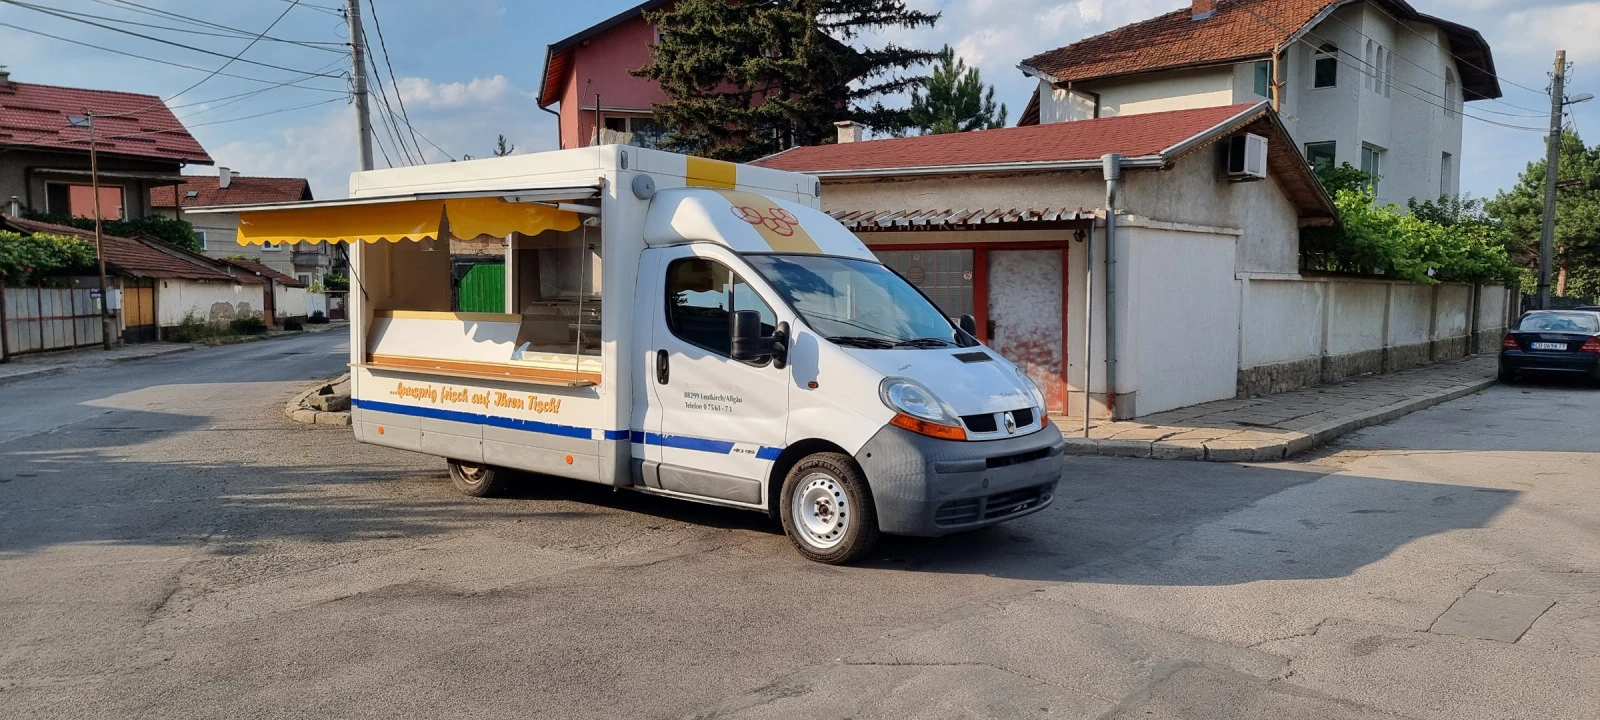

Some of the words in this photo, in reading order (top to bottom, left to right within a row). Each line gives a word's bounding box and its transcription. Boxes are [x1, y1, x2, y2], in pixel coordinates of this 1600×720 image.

[440, 386, 468, 404] frisch
[471, 390, 490, 409] auf
[494, 391, 524, 410] Ihren
[527, 395, 561, 414] Tisch!
[685, 401, 702, 410] Telefon
